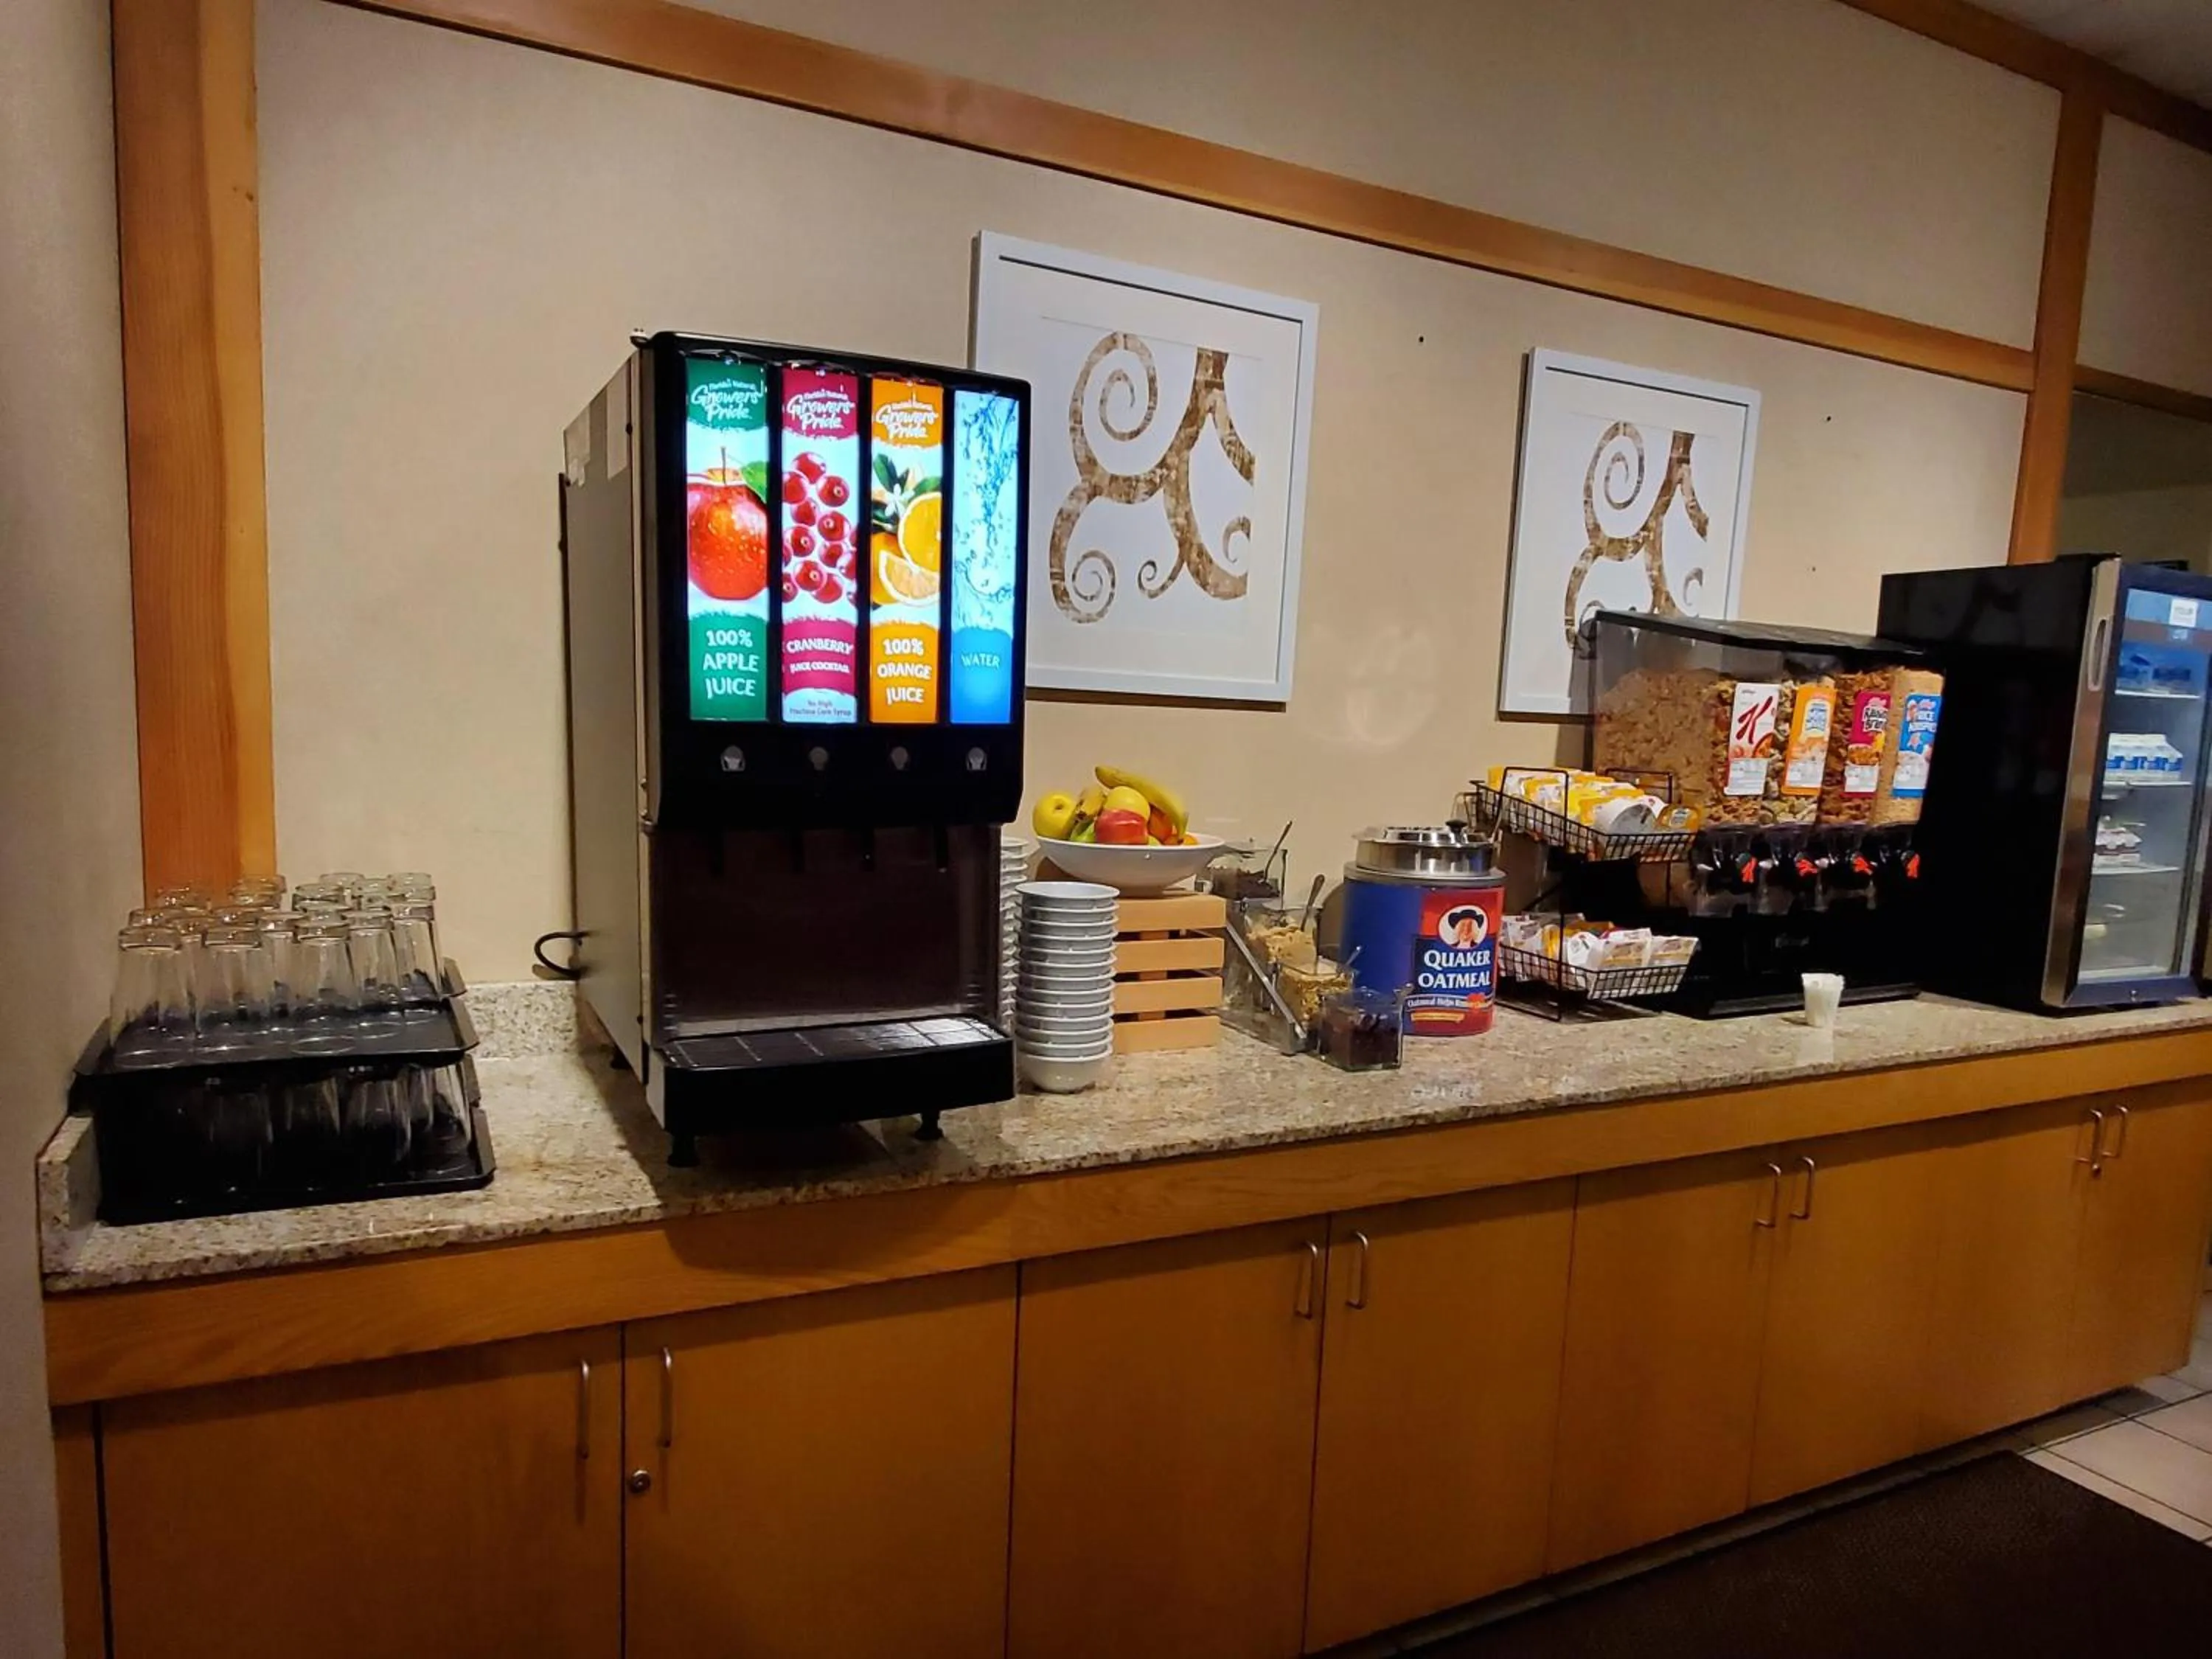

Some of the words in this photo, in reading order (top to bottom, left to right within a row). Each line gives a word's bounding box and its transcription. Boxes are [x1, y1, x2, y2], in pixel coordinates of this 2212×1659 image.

[706, 403, 751, 422] Pride
[801, 412, 844, 430] Pride
[888, 422, 928, 439] Pride
[706, 630, 753, 647] 100%
[787, 638, 854, 655] CRANBERRY
[883, 638, 924, 655] 100%
[703, 653, 759, 672] APPLE
[961, 653, 1000, 668] WATER
[877, 662, 932, 680] ORANGE
[706, 677, 756, 699] JUICE
[886, 687, 925, 706] JUICE
[1424, 950, 1491, 970] QUAKER
[1418, 971, 1491, 989] OATMEAL
